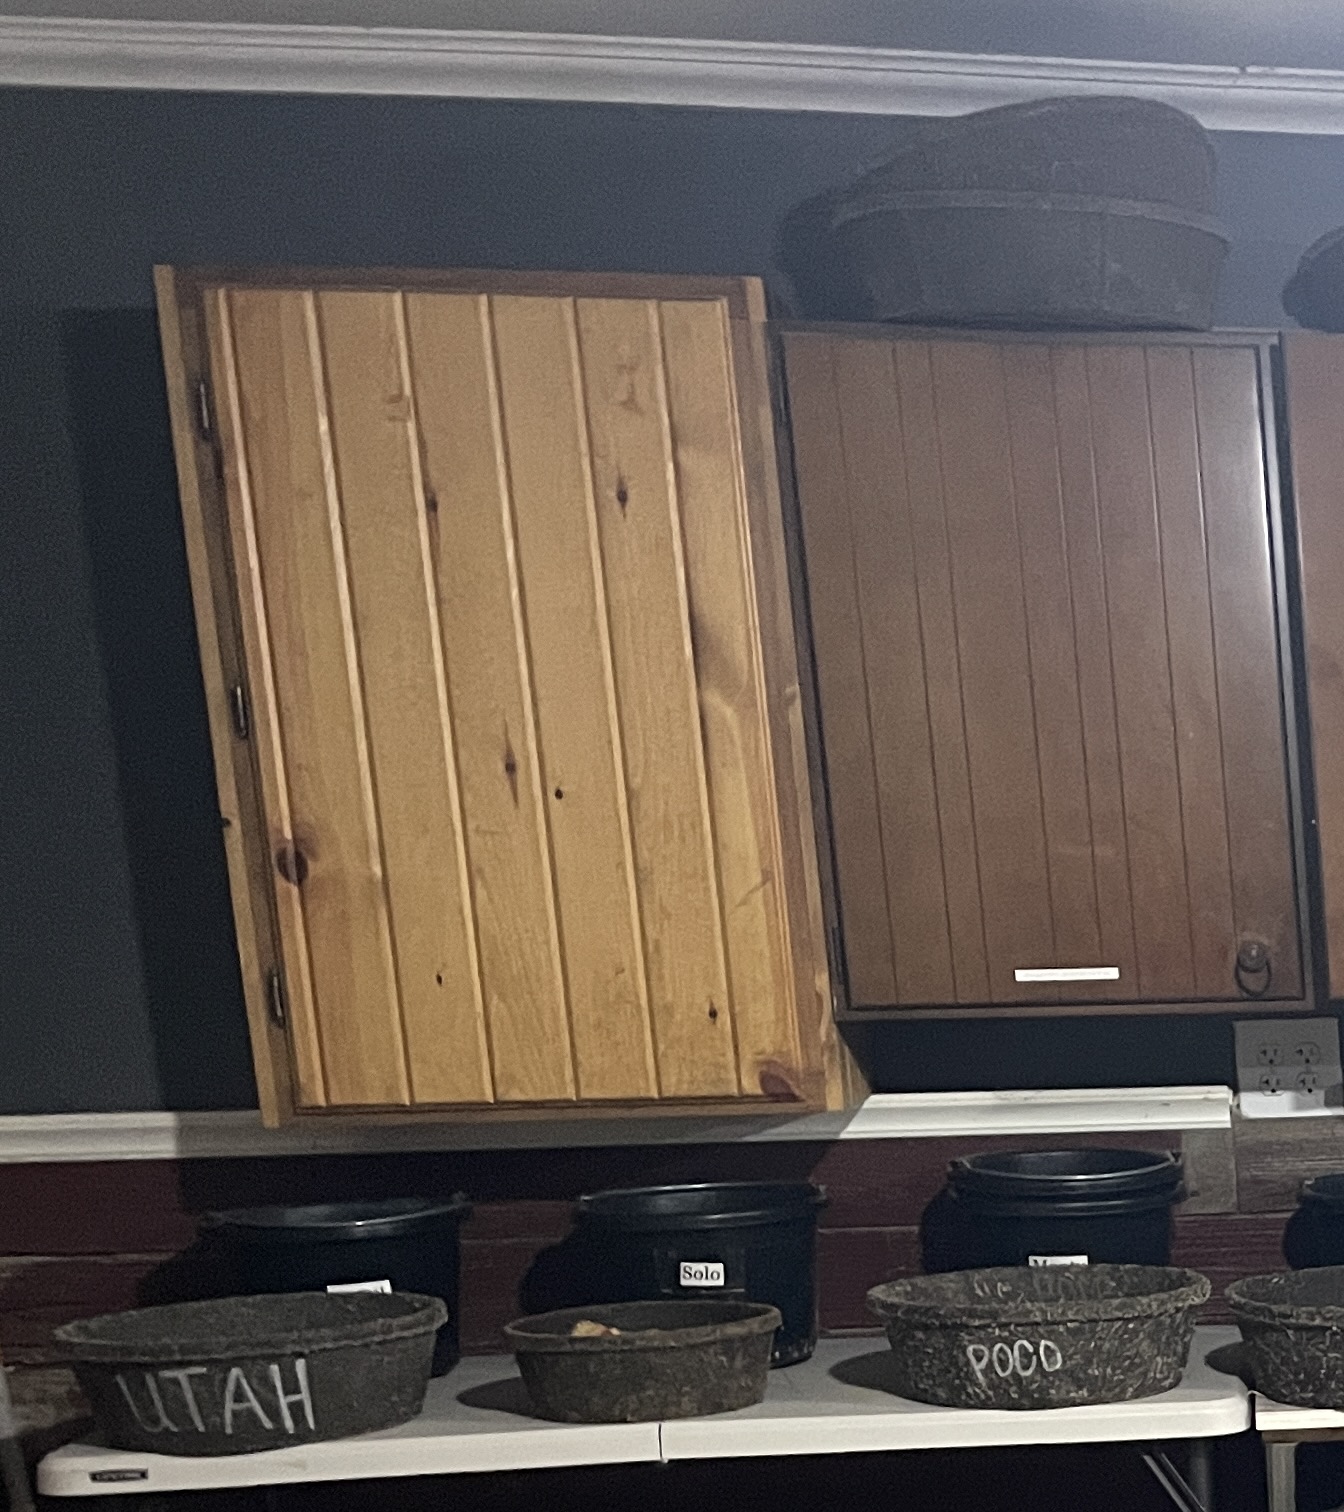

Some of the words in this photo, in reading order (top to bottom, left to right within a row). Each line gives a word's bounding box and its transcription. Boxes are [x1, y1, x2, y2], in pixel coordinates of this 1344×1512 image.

[683, 1265, 721, 1281] Solo
[966, 1339, 1063, 1388] POCO
[115, 1358, 316, 1435] UTAH
